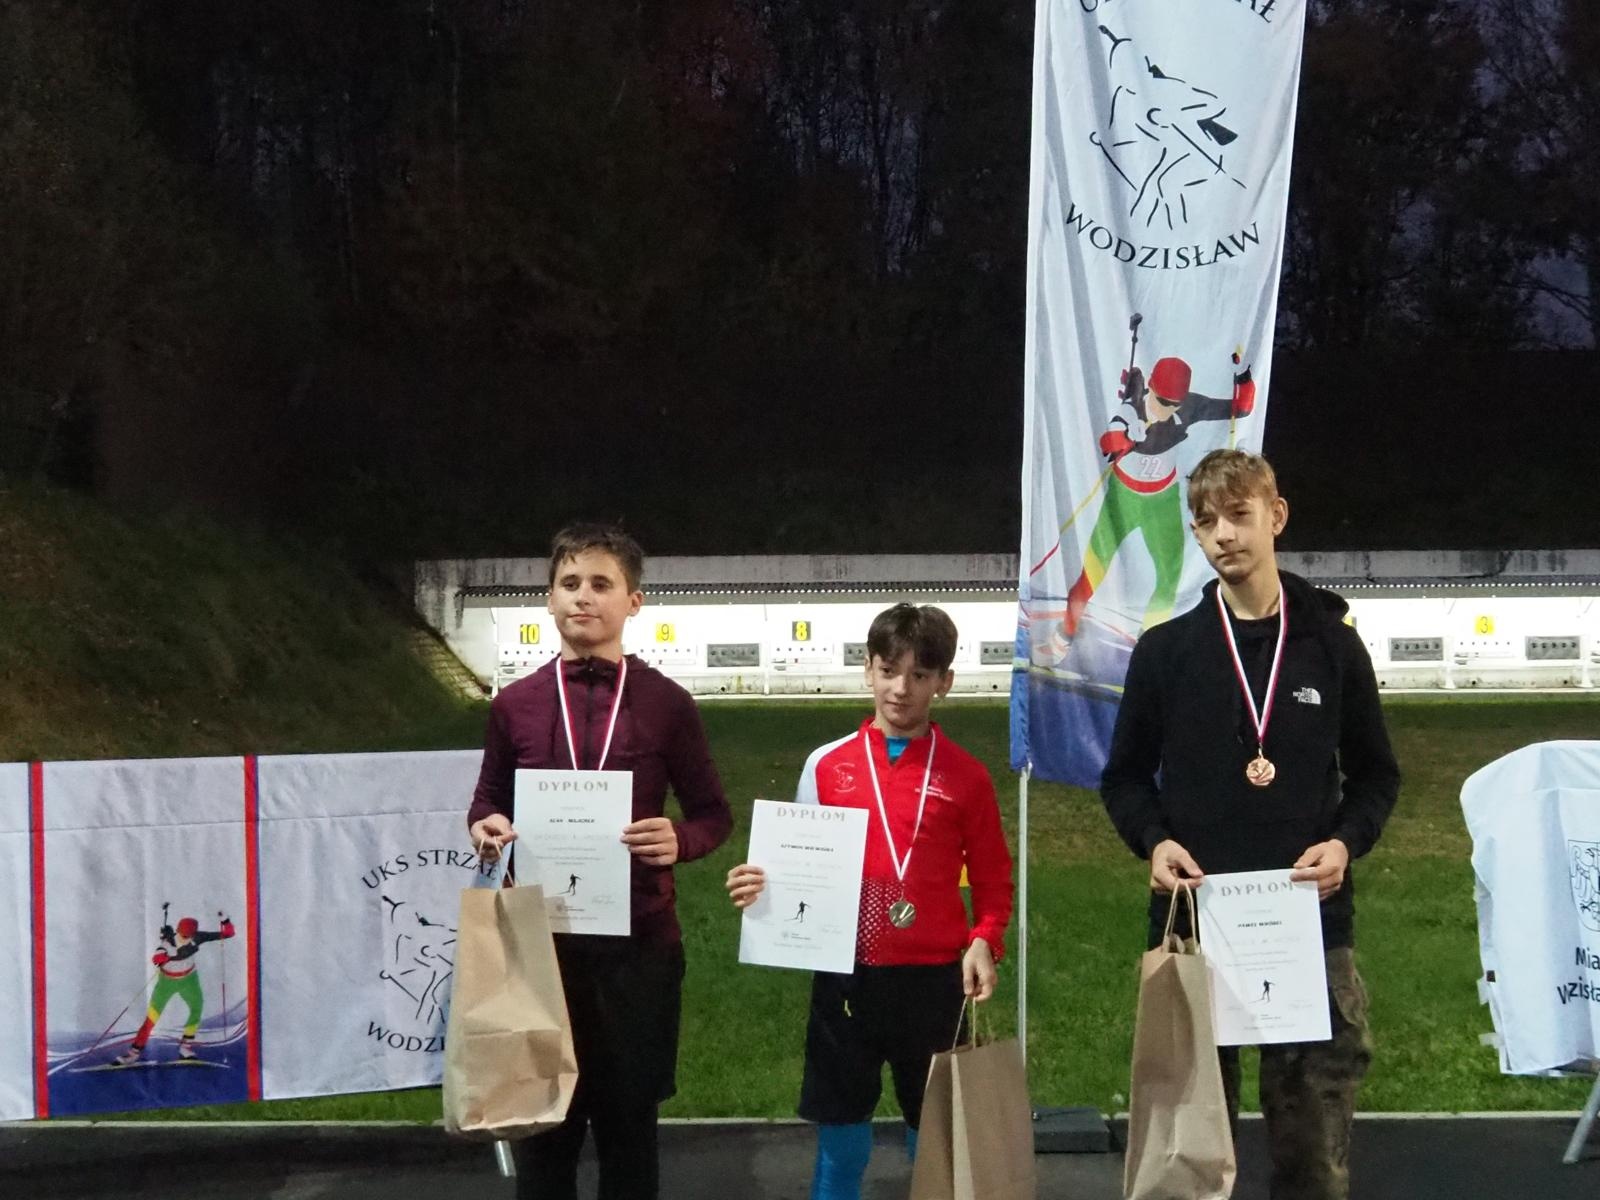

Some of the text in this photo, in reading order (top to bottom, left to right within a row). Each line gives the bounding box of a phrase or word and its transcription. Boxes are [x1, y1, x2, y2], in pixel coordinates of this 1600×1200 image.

[1066, 203, 1260, 269] WODZISŁAW
[520, 624, 539, 644] 10
[795, 621, 808, 641] 8
[538, 780, 609, 792] DYPLOM
[777, 806, 846, 822] DYPLOM
[362, 854, 409, 889] UKS
[1221, 881, 1293, 897] DYPLOM
